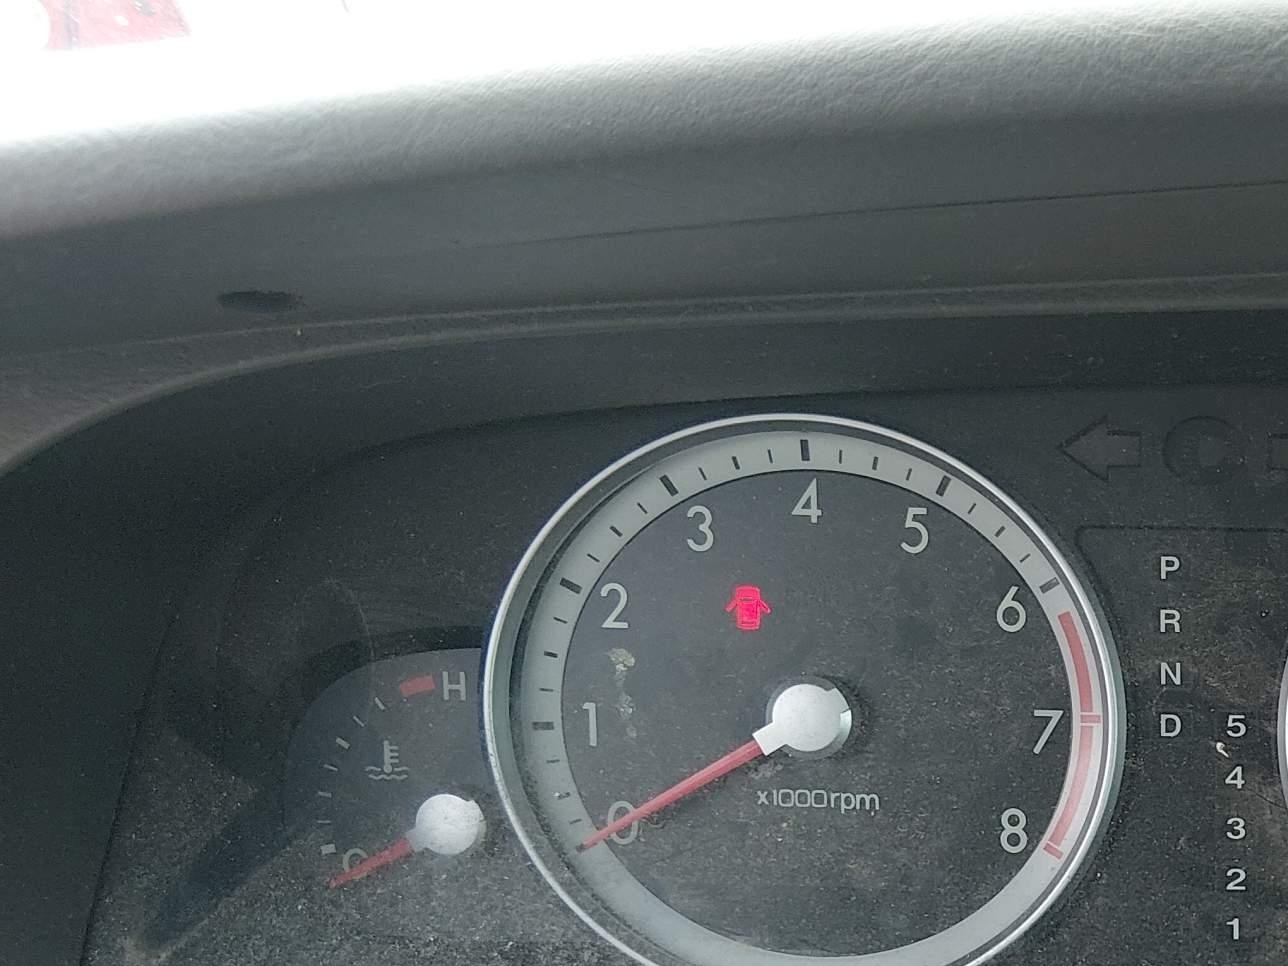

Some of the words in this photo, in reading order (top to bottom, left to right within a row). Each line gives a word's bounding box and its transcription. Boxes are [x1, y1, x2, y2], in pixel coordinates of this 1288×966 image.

[791, 478, 823, 524] 4
[685, 504, 715, 553] 3
[899, 507, 930, 554] 5
[1160, 556, 1180, 580] P
[600, 582, 630, 630] 2
[995, 585, 1027, 633] 6
[1160, 609, 1180, 633] R
[442, 671, 466, 700] H
[1160, 663, 1181, 686] N
[582, 701, 599, 747] 1
[1032, 709, 1064, 755] 7
[1160, 714, 1182, 738] D
[1226, 715, 1247, 738] 5
[1224, 766, 1245, 789] 4
[605, 800, 639, 845] 0
[999, 807, 1028, 854] 8
[1226, 818, 1246, 840] 3
[1226, 869, 1246, 889] 2
[1226, 919, 1240, 939] 1
